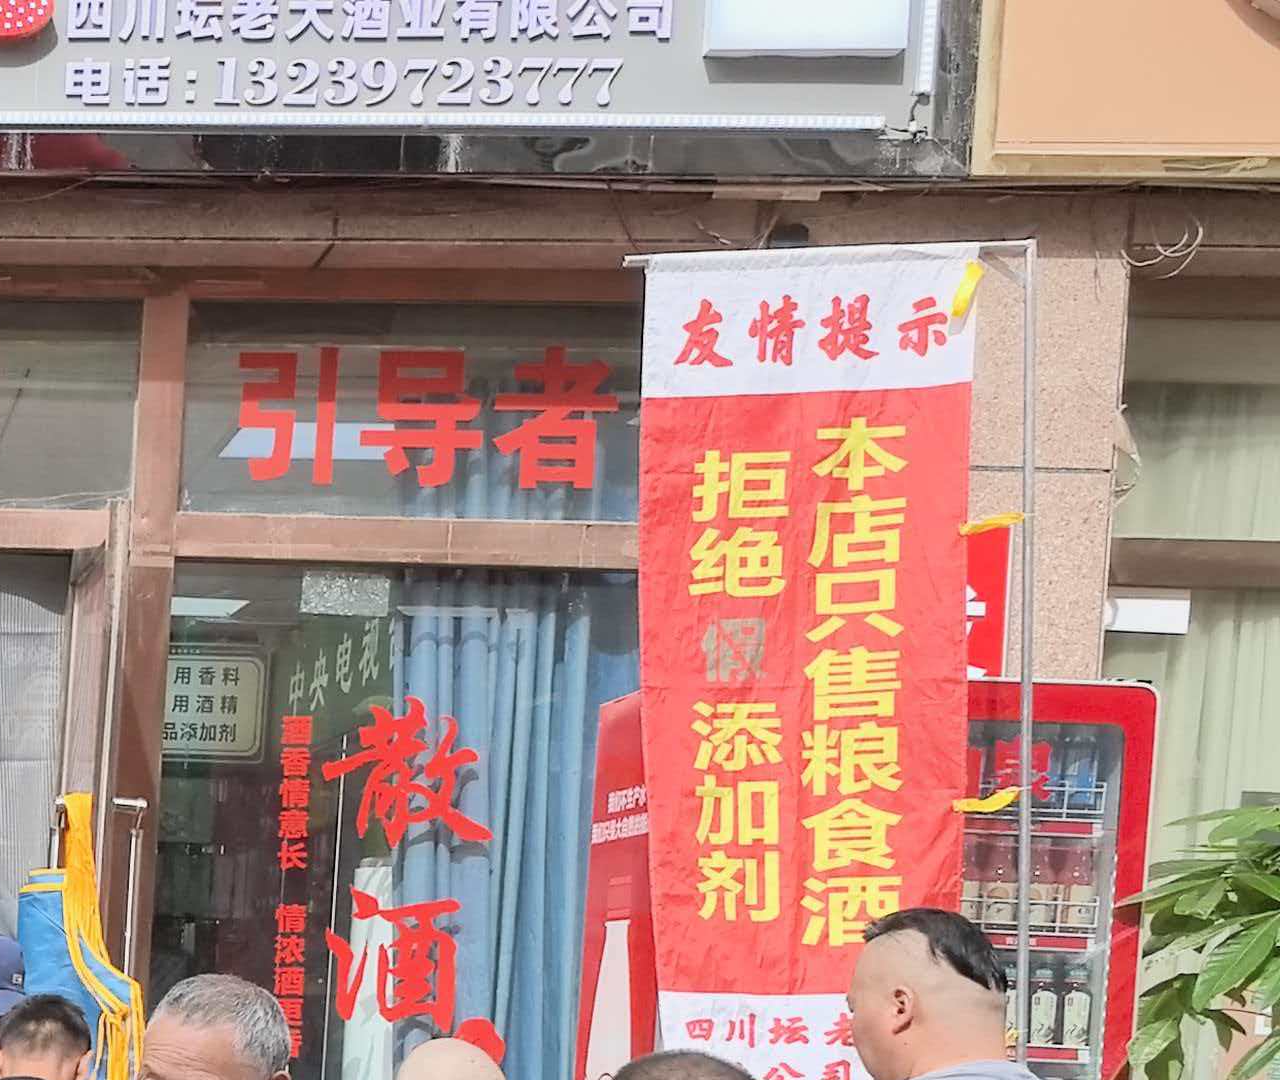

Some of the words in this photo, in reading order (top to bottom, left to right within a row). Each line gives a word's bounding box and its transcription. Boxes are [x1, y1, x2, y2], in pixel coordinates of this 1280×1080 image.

[67, 0, 673, 40] 四川坛老大酒业有限公司
[674, 294, 950, 368] 友情提示
[239, 345, 619, 489] 引导者
[800, 417, 908, 947] 本店只售粮食酒
[277, 716, 313, 870] 酒香情意长
